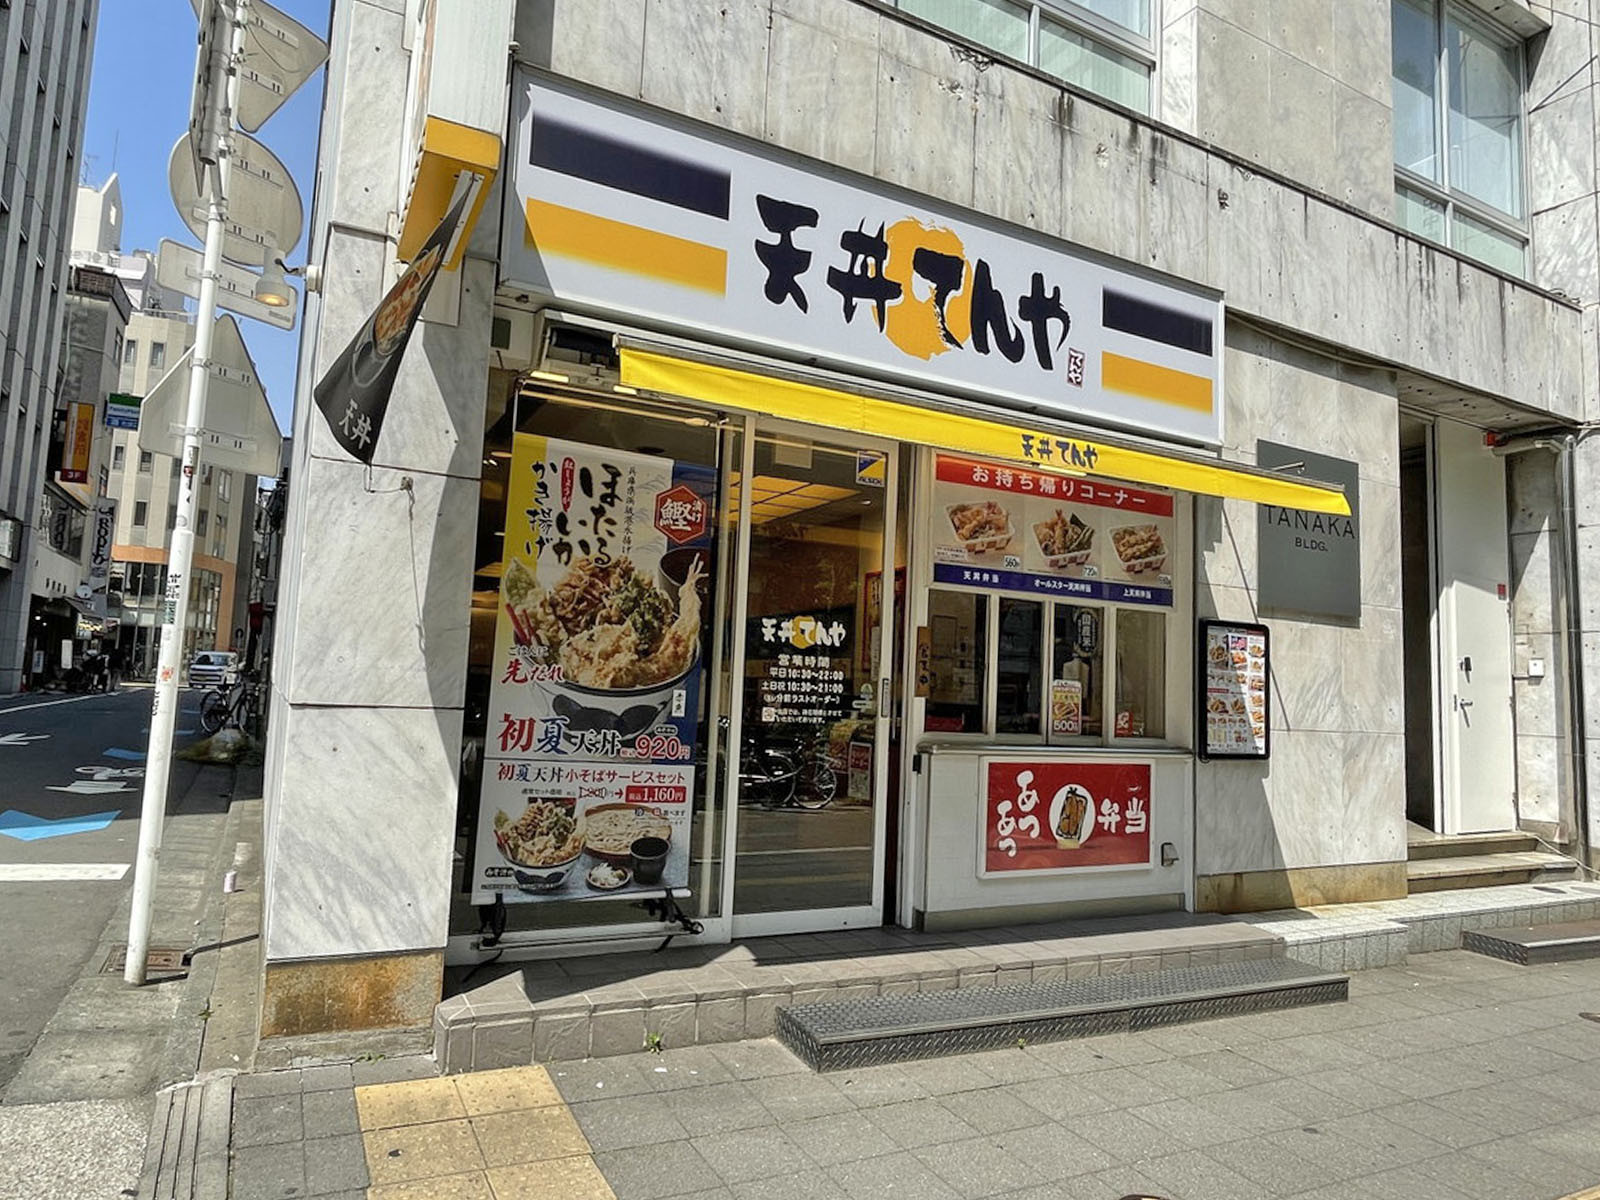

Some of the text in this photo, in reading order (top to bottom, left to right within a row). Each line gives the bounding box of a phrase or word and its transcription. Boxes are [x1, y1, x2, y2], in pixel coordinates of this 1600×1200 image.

[754, 194, 1071, 371] 天丼てんや
[338, 398, 373, 450] 天丼
[1021, 434, 1099, 469] 天丼てんや
[972, 465, 1146, 505] お持ち帰りコーナー
[525, 461, 557, 561] かき揚げ
[1263, 504, 1355, 539] TANAKA
[1295, 537, 1328, 552] BLDG.
[963, 570, 1000, 583] 天丼弁当
[761, 617, 847, 648] 天丼てんや
[778, 654, 831, 668] 営業時間
[497, 713, 622, 756] 初夏天丼
[497, 762, 686, 785] 初夏天丼小そばサービスセット
[1097, 797, 1147, 835] 弁当
